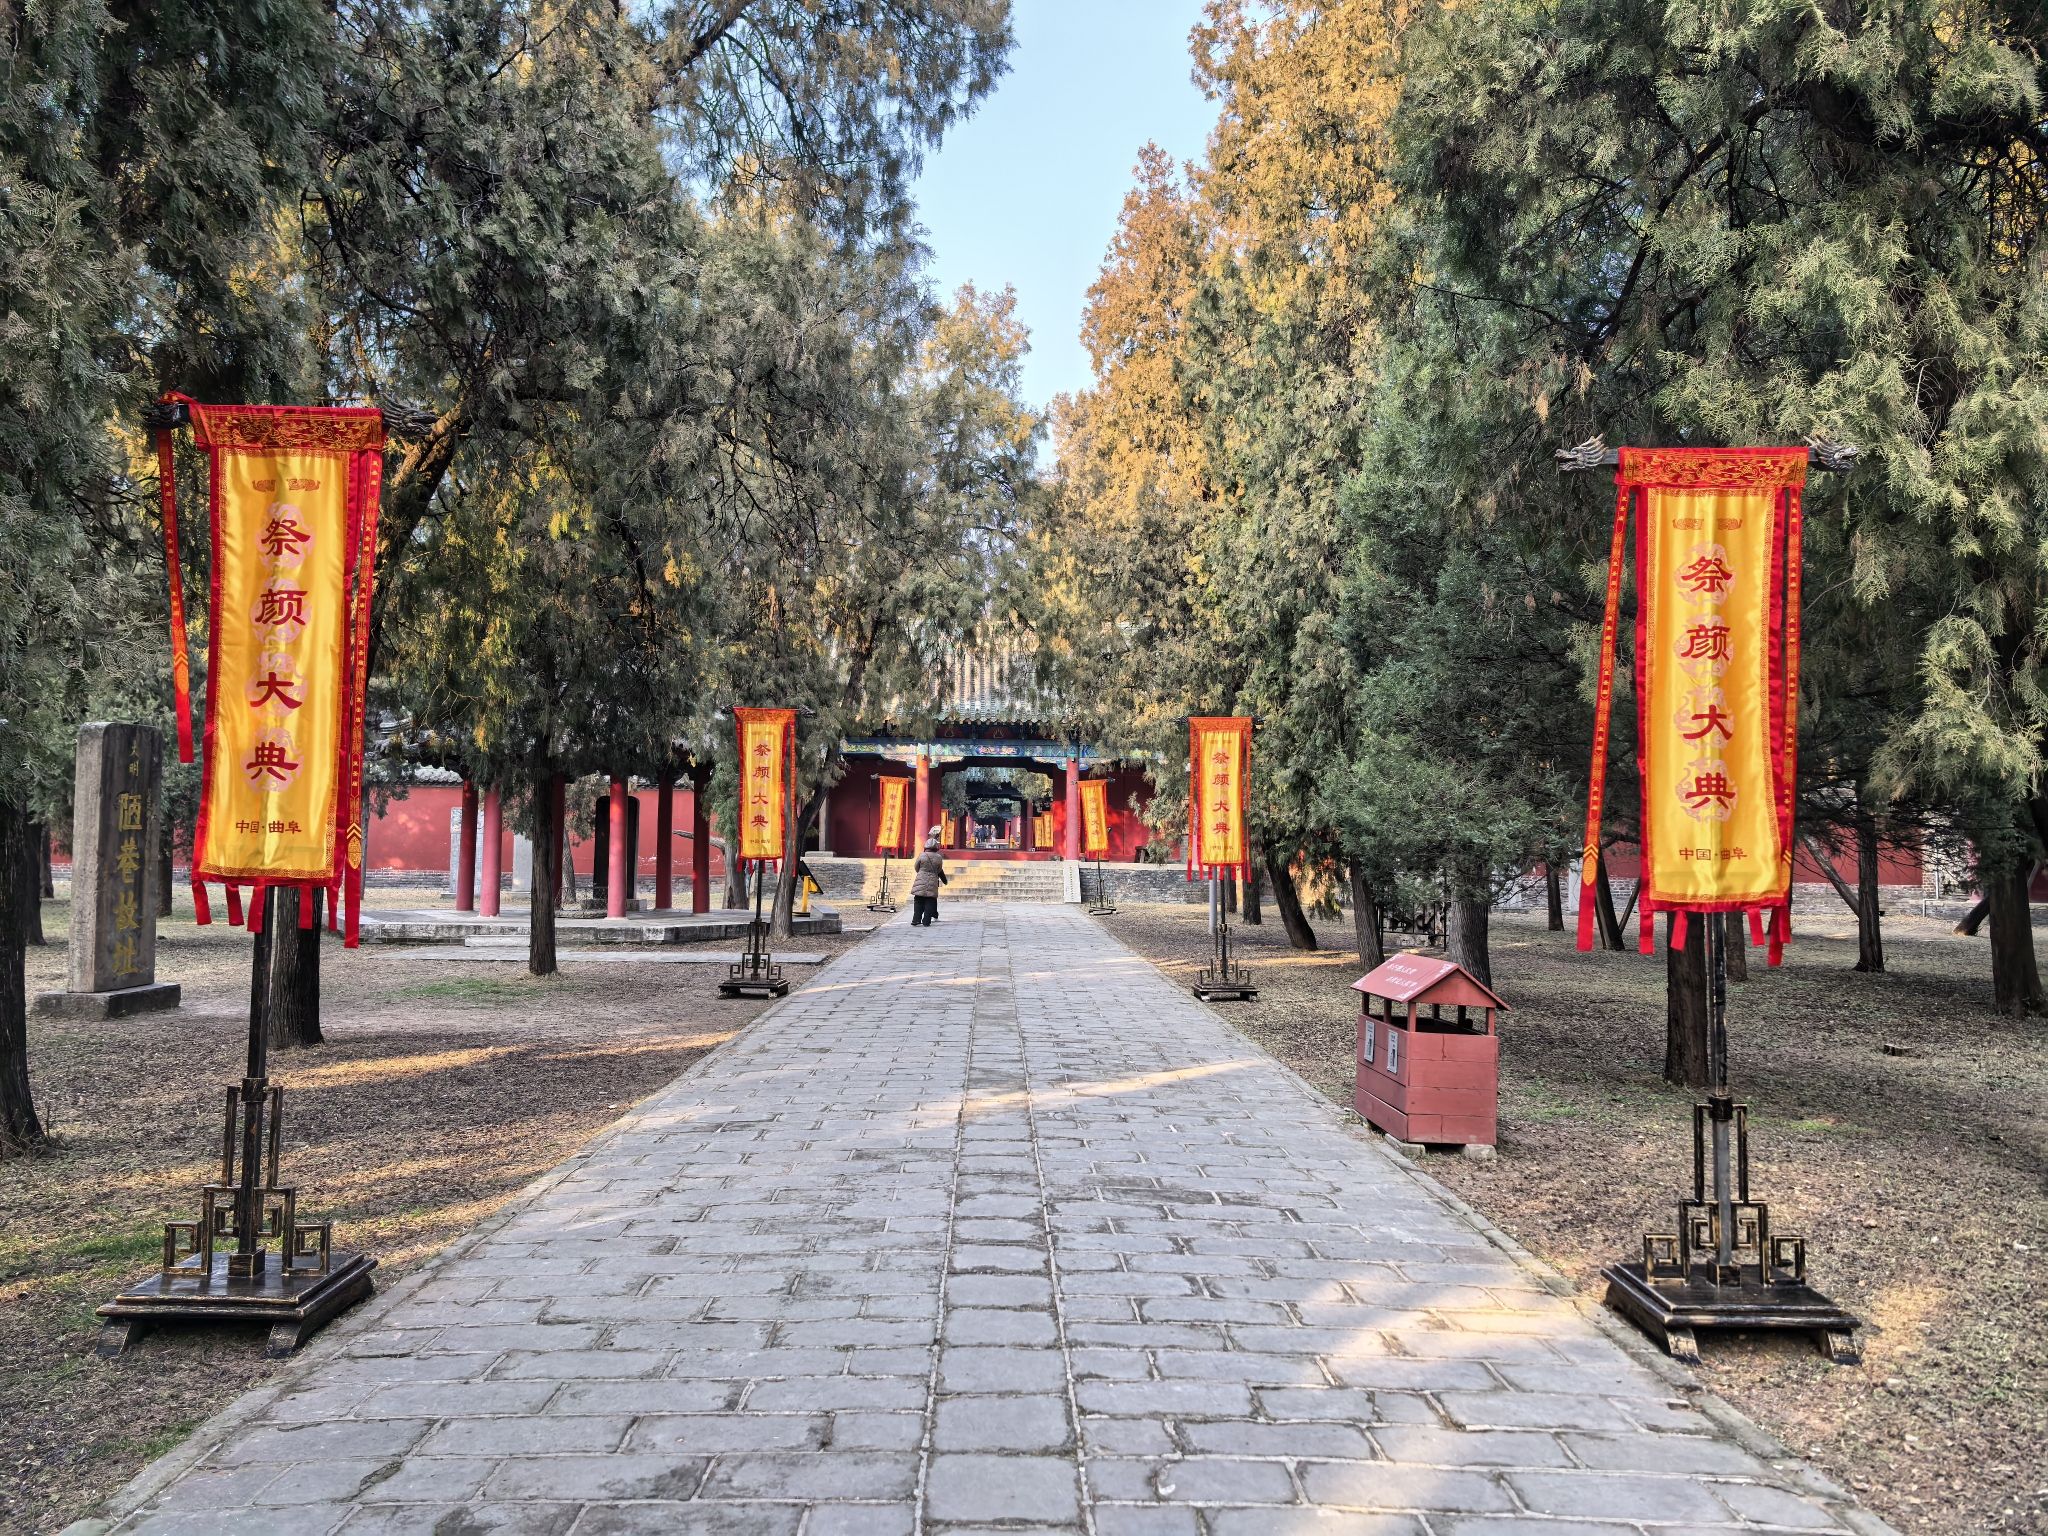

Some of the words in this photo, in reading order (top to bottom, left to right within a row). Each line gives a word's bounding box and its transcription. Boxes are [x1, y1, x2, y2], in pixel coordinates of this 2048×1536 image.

[247, 518, 311, 781] 祭颜大典
[1681, 556, 1736, 811] 祭颜大典
[751, 743, 771, 828] 祭颜大典
[1212, 752, 1231, 835] 祭颜大典
